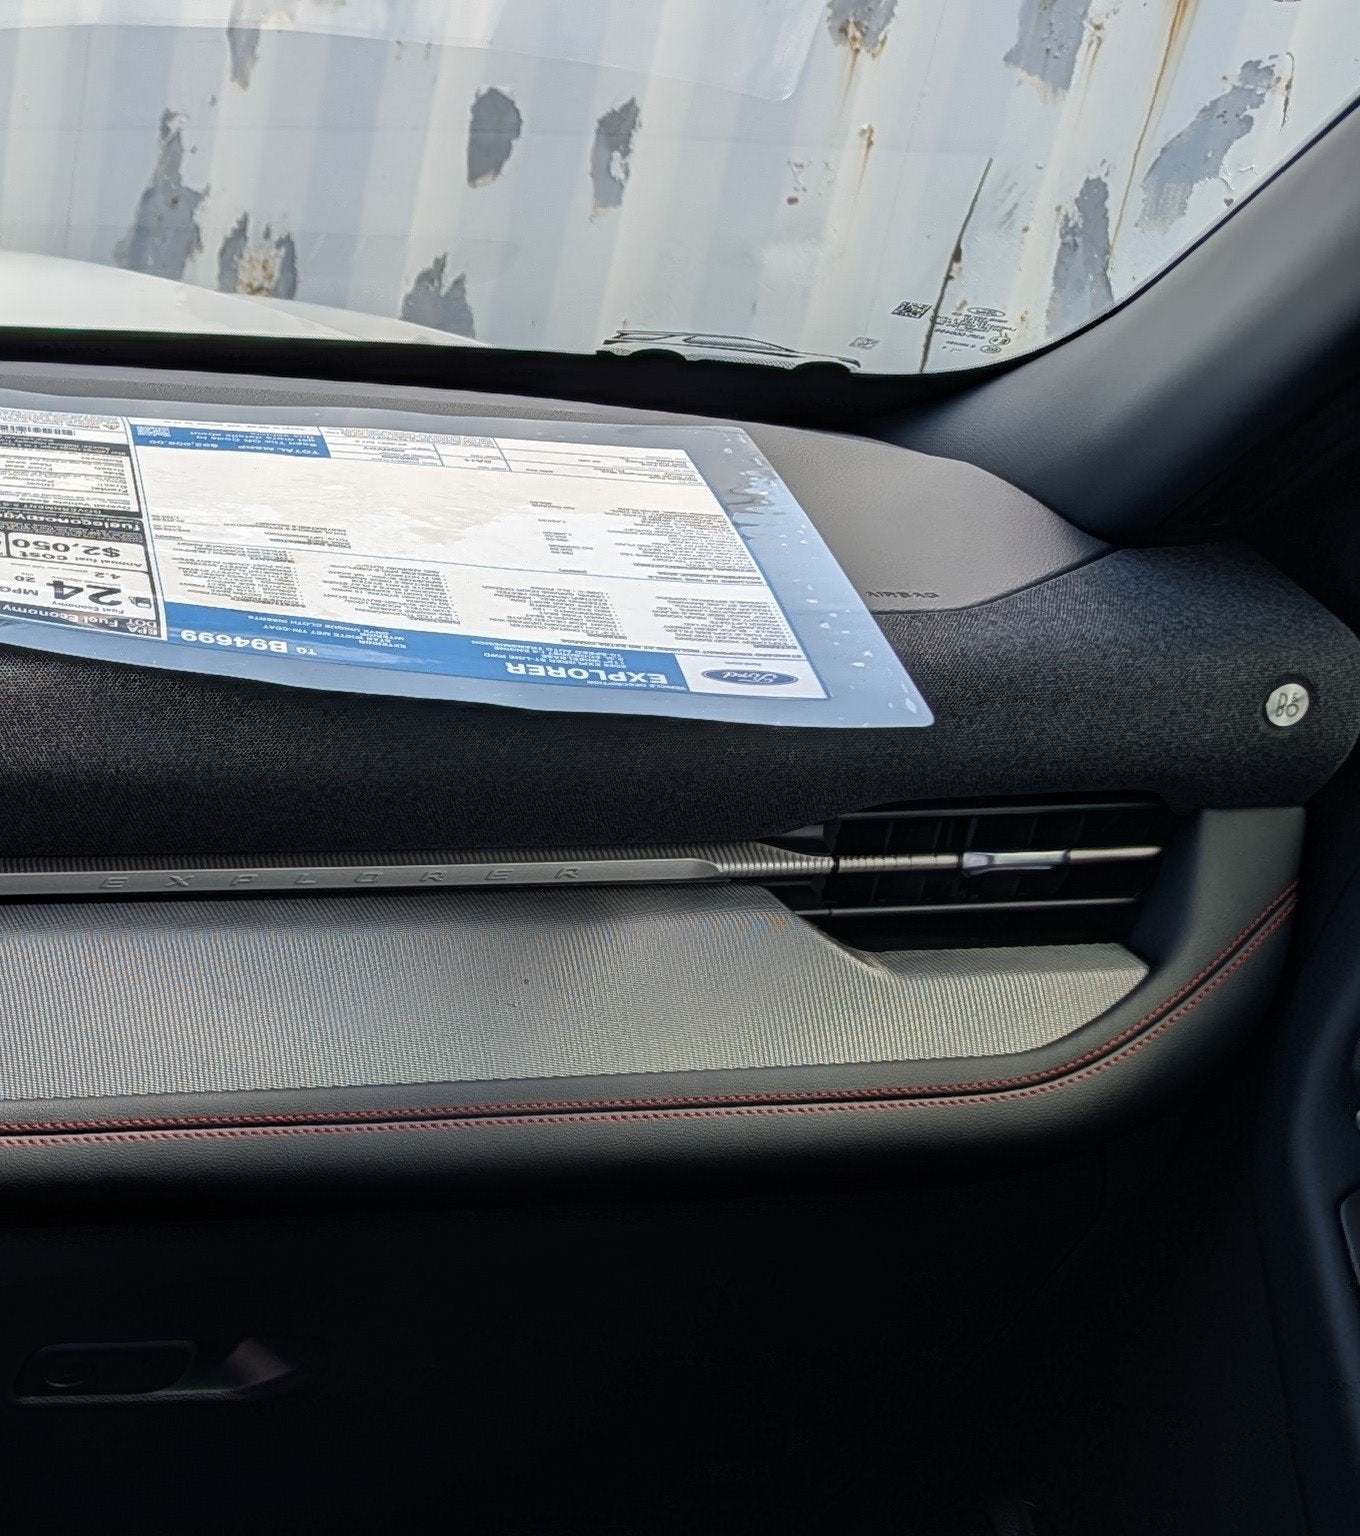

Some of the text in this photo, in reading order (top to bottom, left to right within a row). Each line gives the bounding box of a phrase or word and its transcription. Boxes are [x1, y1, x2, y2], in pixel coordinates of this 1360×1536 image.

[12, 538, 121, 558] $2,050
[17, 551, 68, 561] cost
[47, 580, 123, 607] 24
[1, 603, 80, 623] Economy
[85, 616, 119, 627] Fuel
[179, 629, 288, 654] B94699
[505, 662, 668, 684] EXPLORER
[722, 671, 778, 684] Ford
